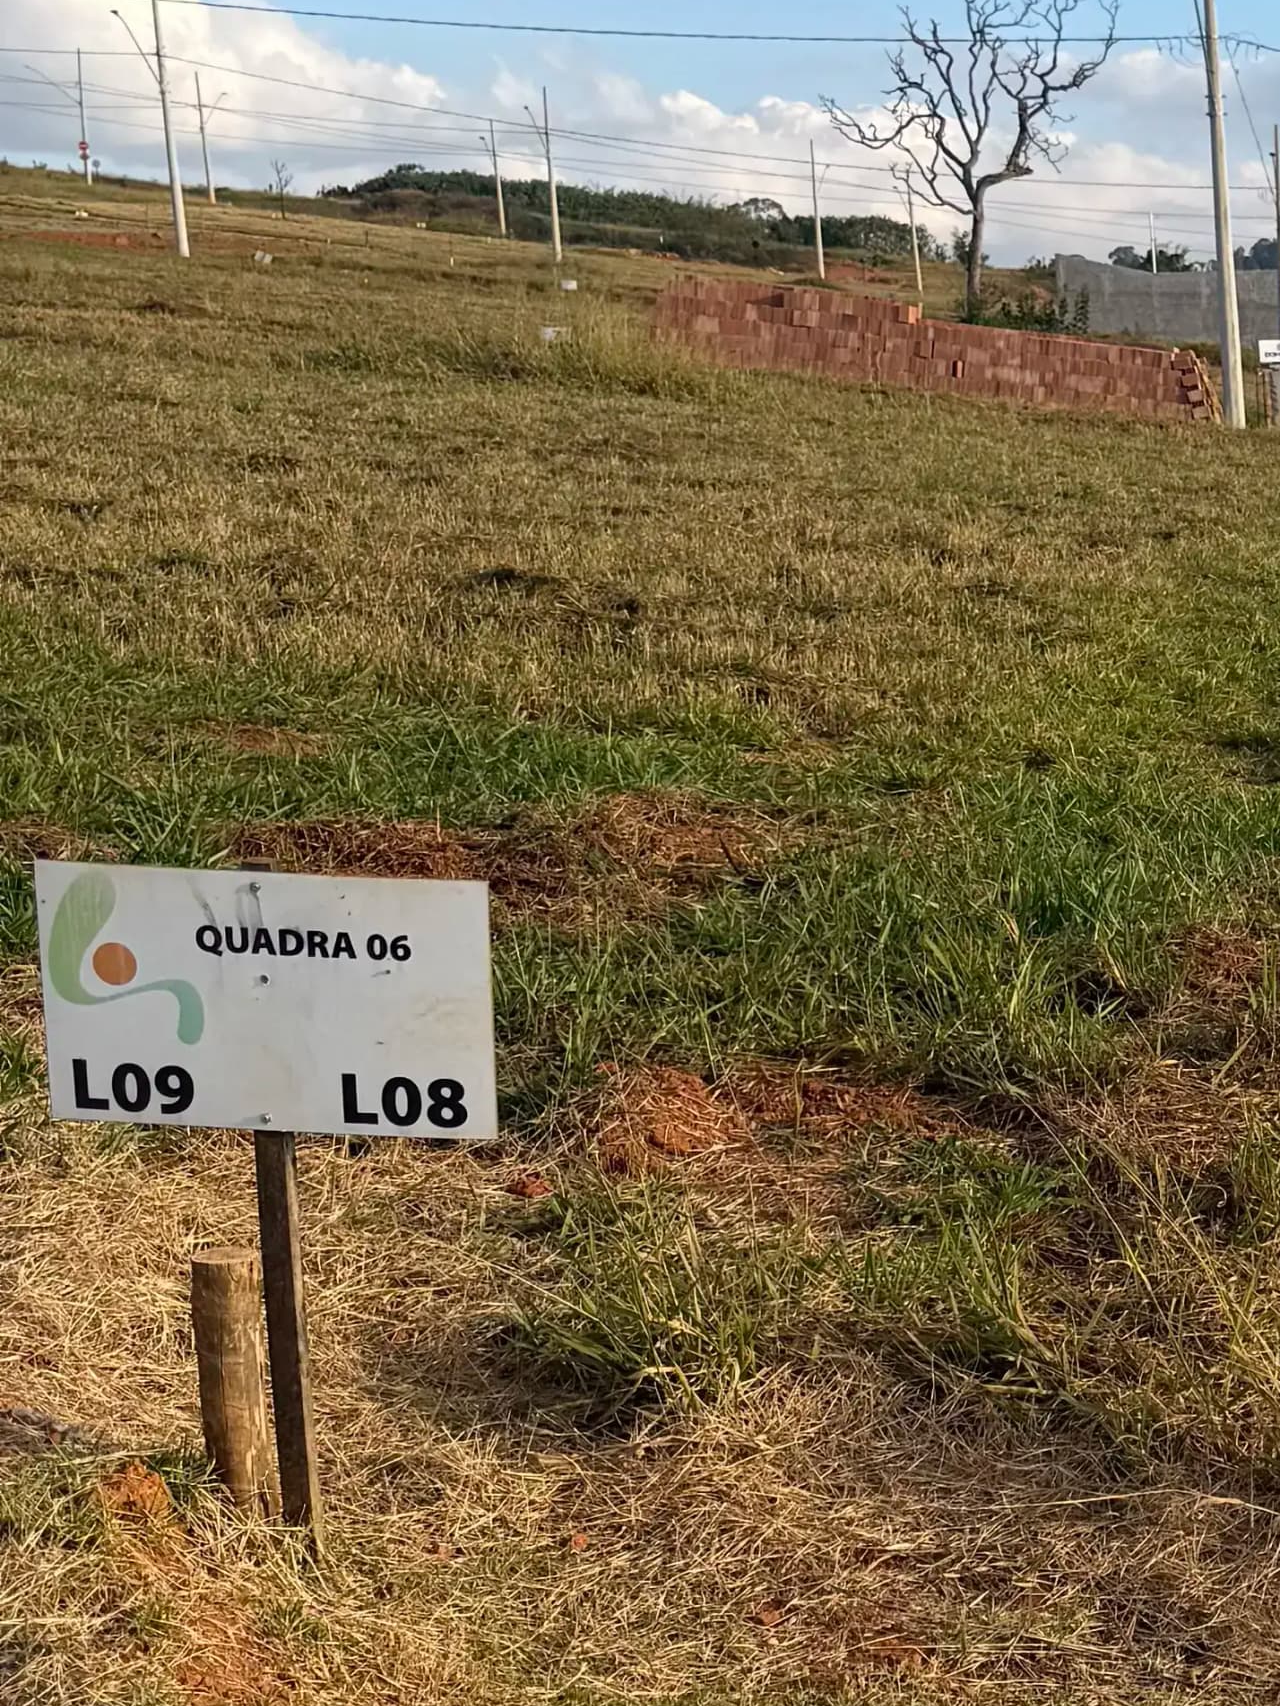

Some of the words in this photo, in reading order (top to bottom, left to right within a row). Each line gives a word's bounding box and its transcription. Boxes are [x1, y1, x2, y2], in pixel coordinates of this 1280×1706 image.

[195, 923, 357, 960] QUADRA
[366, 933, 412, 962] 06
[71, 1058, 195, 1115] L09
[341, 1072, 469, 1129] L08
